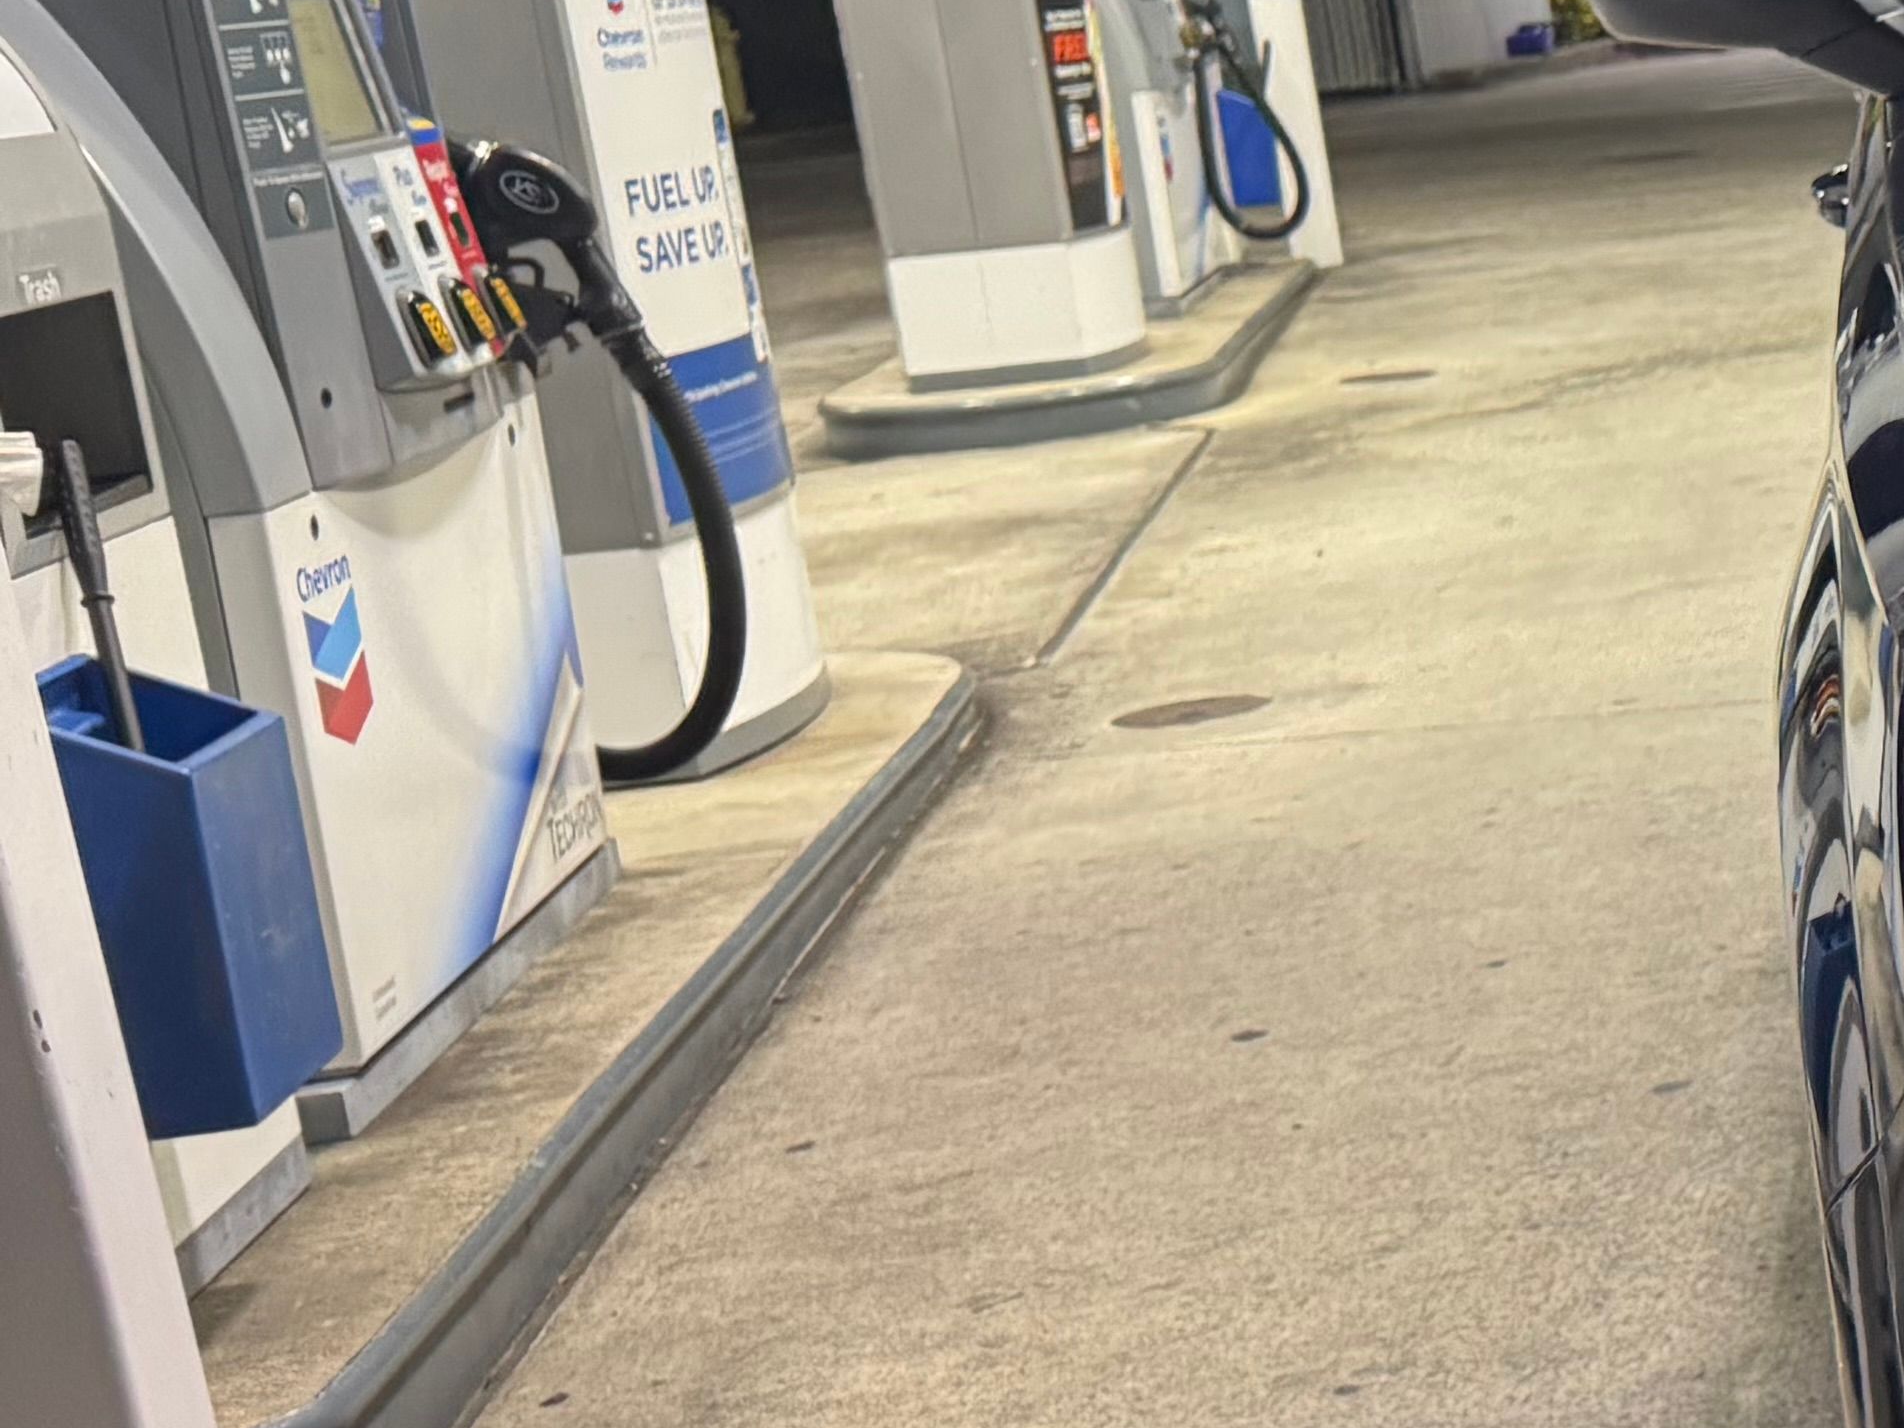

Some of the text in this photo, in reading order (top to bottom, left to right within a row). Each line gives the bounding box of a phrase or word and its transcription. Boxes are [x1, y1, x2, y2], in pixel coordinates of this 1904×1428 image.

[624, 165, 720, 219] FUEL UP.
[636, 220, 730, 274] SAVE UP.
[296, 553, 352, 603] Chevron
